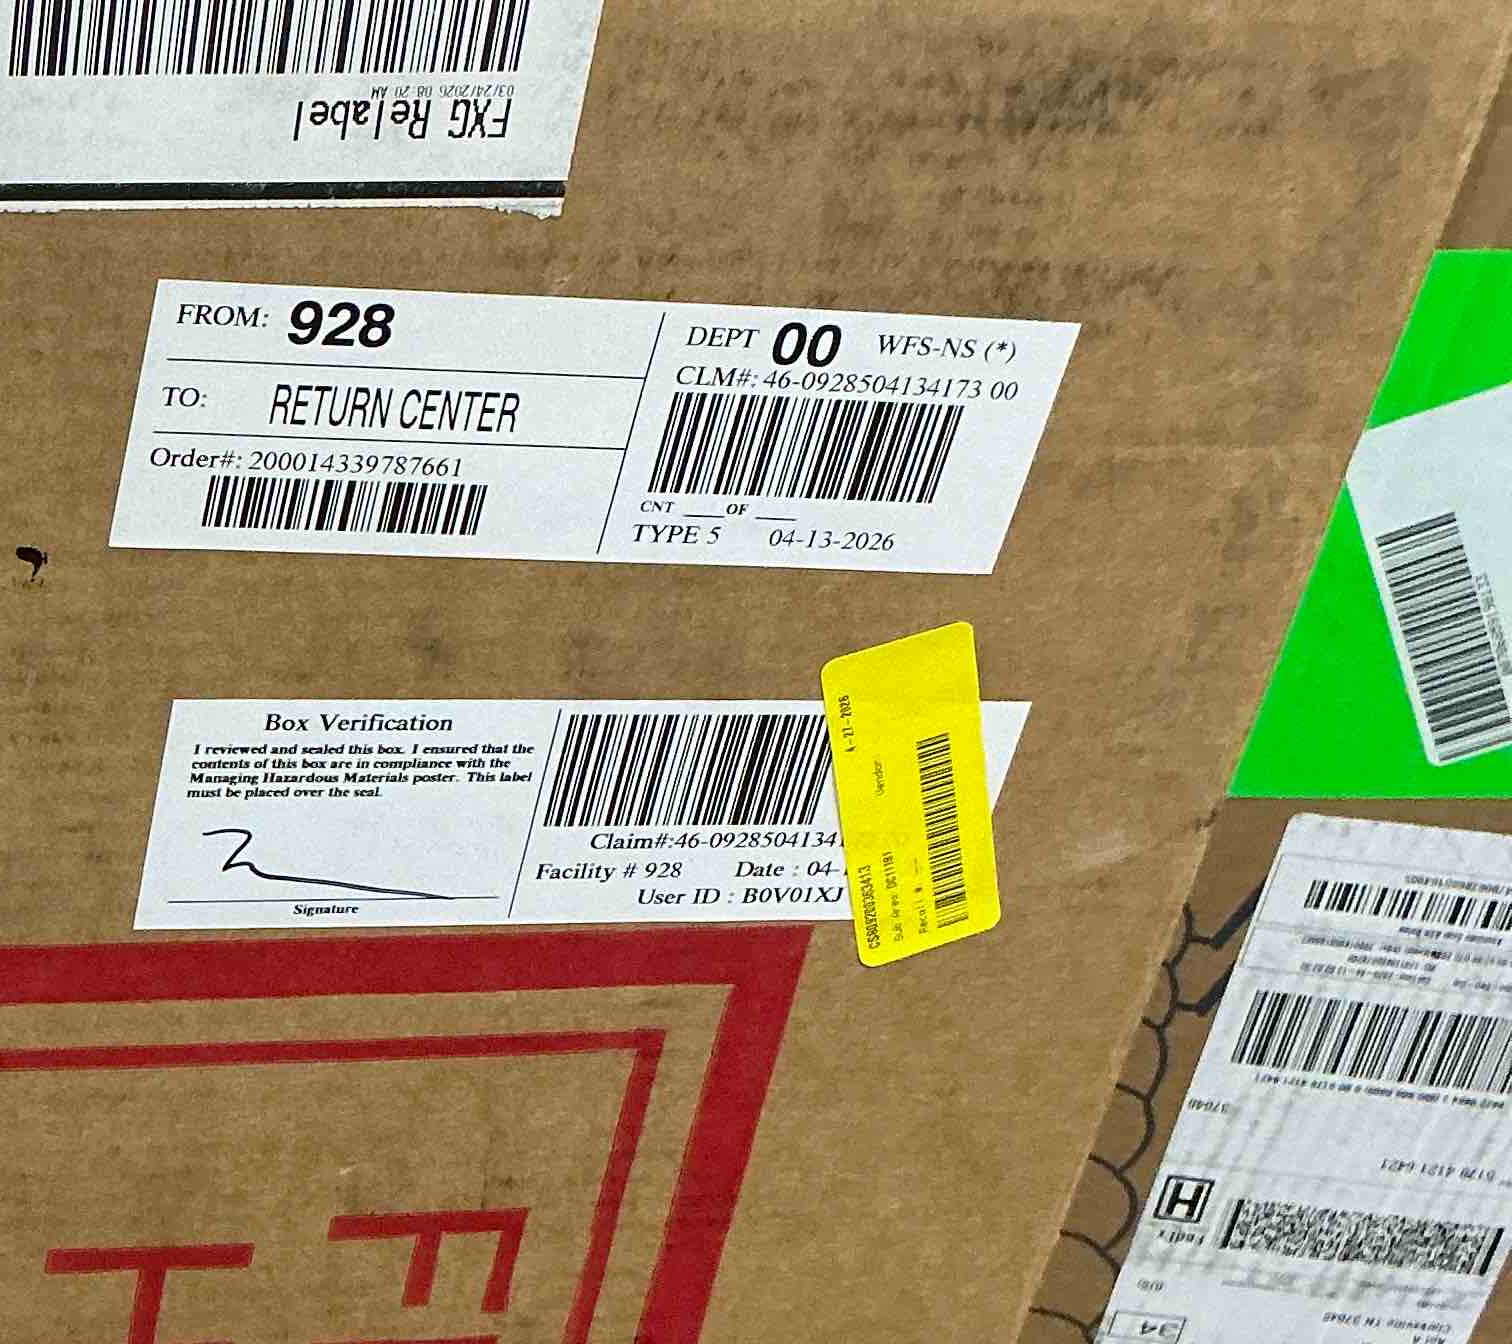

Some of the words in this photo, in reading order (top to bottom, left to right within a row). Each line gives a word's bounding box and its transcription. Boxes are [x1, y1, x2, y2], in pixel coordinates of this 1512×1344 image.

[370, 85, 388, 99] AM
[440, 84, 515, 97] 03/24/2026
[293, 99, 432, 142] Relabel
[448, 98, 513, 139] FXG
[176, 303, 269, 328] FROM:
[287, 300, 395, 348] 928
[685, 325, 760, 350] DEPT
[773, 321, 842, 367] 00
[877, 334, 977, 358] WFS-NS
[676, 365, 758, 389] CLM#:
[763, 370, 982, 400] 46-0928504134173
[989, 380, 1020, 401] 00
[162, 386, 208, 409] TO:
[269, 383, 392, 428] RETURN
[399, 388, 521, 433] CENTER
[149, 446, 243, 470] Order#:
[248, 450, 463, 477] 200014339787661
[639, 500, 675, 514] CNT
[726, 503, 749, 516] OF
[631, 524, 703, 545] TYPE
[706, 526, 720, 545] 5
[768, 529, 895, 551] 04-13-2026
[264, 713, 311, 731] Box
[320, 713, 453, 731] Verification
[193, 744, 201, 755] I
[205, 744, 268, 755] reviewed
[270, 744, 297, 755] and
[301, 744, 344, 755] sealed
[348, 744, 374, 755] this
[411, 744, 418, 755] I
[422, 744, 478, 755] ensured
[481, 744, 508, 755] that
[512, 744, 535, 755] the
[191, 759, 250, 769] contents
[253, 759, 269, 769] of
[272, 759, 298, 769] this
[301, 759, 327, 769] box
[330, 760, 353, 769] are
[356, 759, 370, 769] in
[373, 759, 453, 771] compliance
[456, 759, 486, 769] with
[489, 759, 511, 769] the
[189, 772, 259, 786] Managing
[262, 773, 339, 783] Hazardous
[343, 773, 409, 783] Materials
[412, 773, 461, 785] poster.
[467, 772, 496, 783] This
[499, 772, 532, 782] label
[186, 787, 222, 798] must
[225, 787, 242, 798] be
[244, 787, 289, 800] placed
[293, 787, 325, 798] over
[327, 787, 350, 798] the
[536, 862, 617, 881] Facility
[622, 862, 637, 878] #
[644, 862, 683, 879] 928
[735, 861, 786, 878] Date
[638, 888, 688, 906] User
[692, 888, 721, 906] ID
[292, 903, 359, 916] Signature
[1165, 1180, 1205, 1219] H
